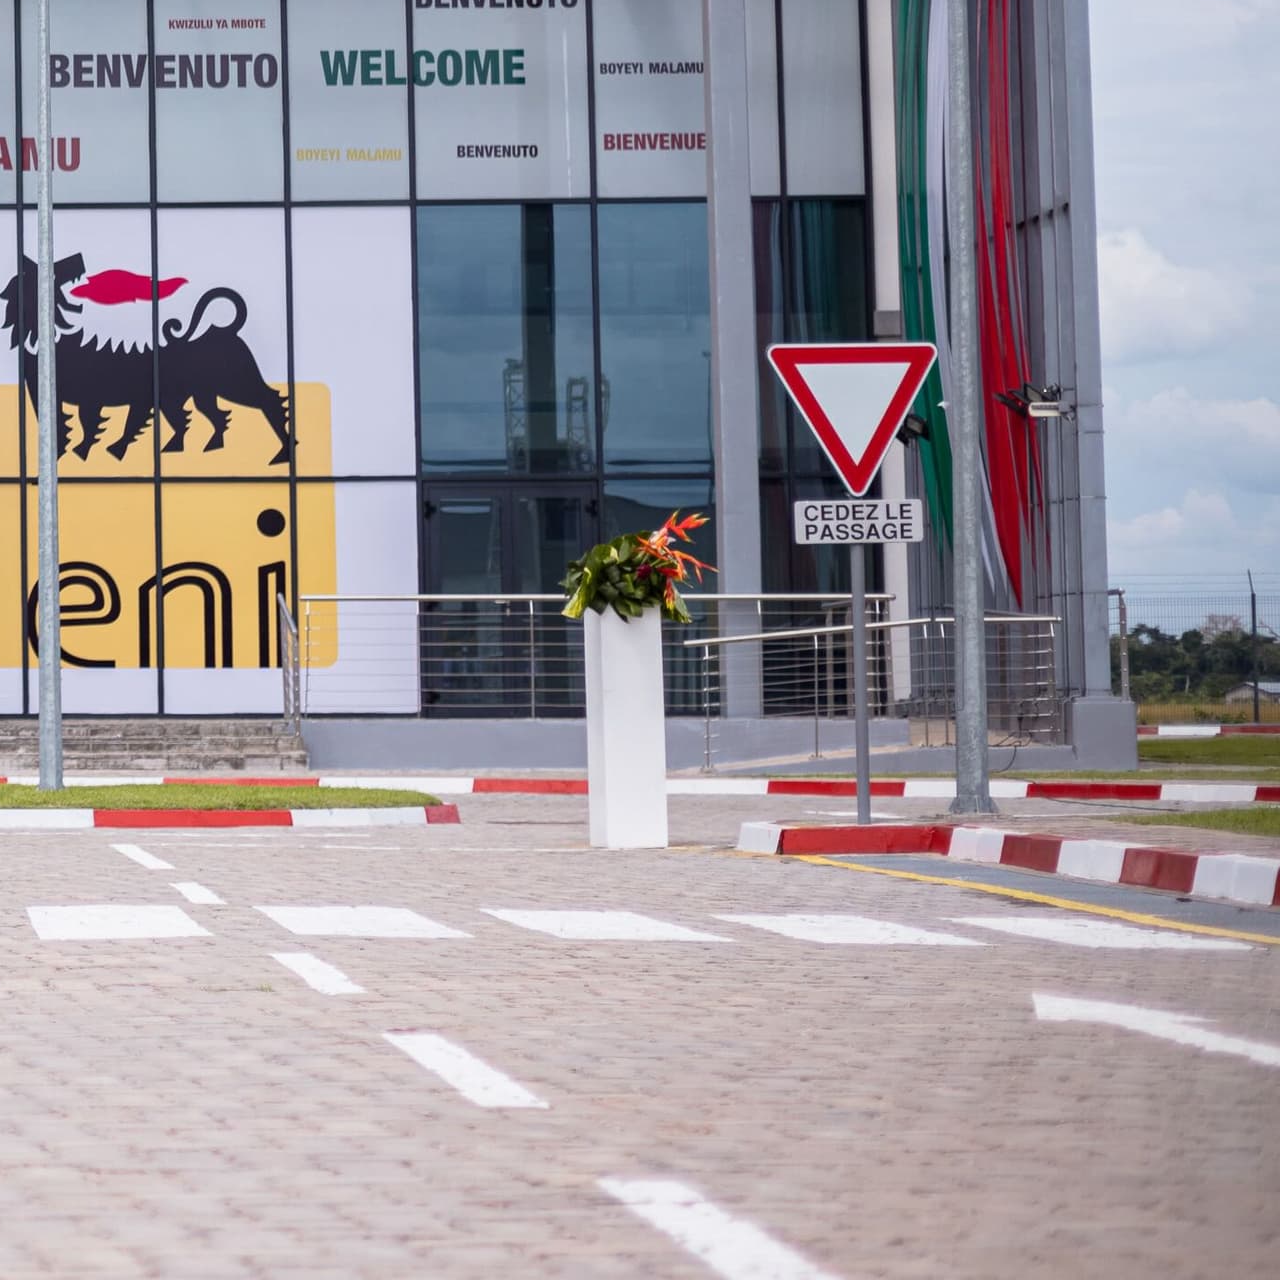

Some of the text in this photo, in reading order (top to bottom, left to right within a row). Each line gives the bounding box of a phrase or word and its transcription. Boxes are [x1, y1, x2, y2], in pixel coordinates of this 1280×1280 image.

[168, 18, 266, 30] KWIZULU YA MBOTE
[49, 54, 278, 88] BENVENUTO
[320, 49, 526, 86] WELCOME
[599, 62, 705, 75] BOYEYI MALAMU
[603, 133, 707, 151] BIENVENUE
[296, 148, 402, 161] BOYEYI MALAMU
[457, 145, 539, 158] BENVENUTO
[804, 503, 913, 521] CEDEZ LE
[805, 523, 913, 541] PASSAGE
[28, 508, 287, 669] eni
